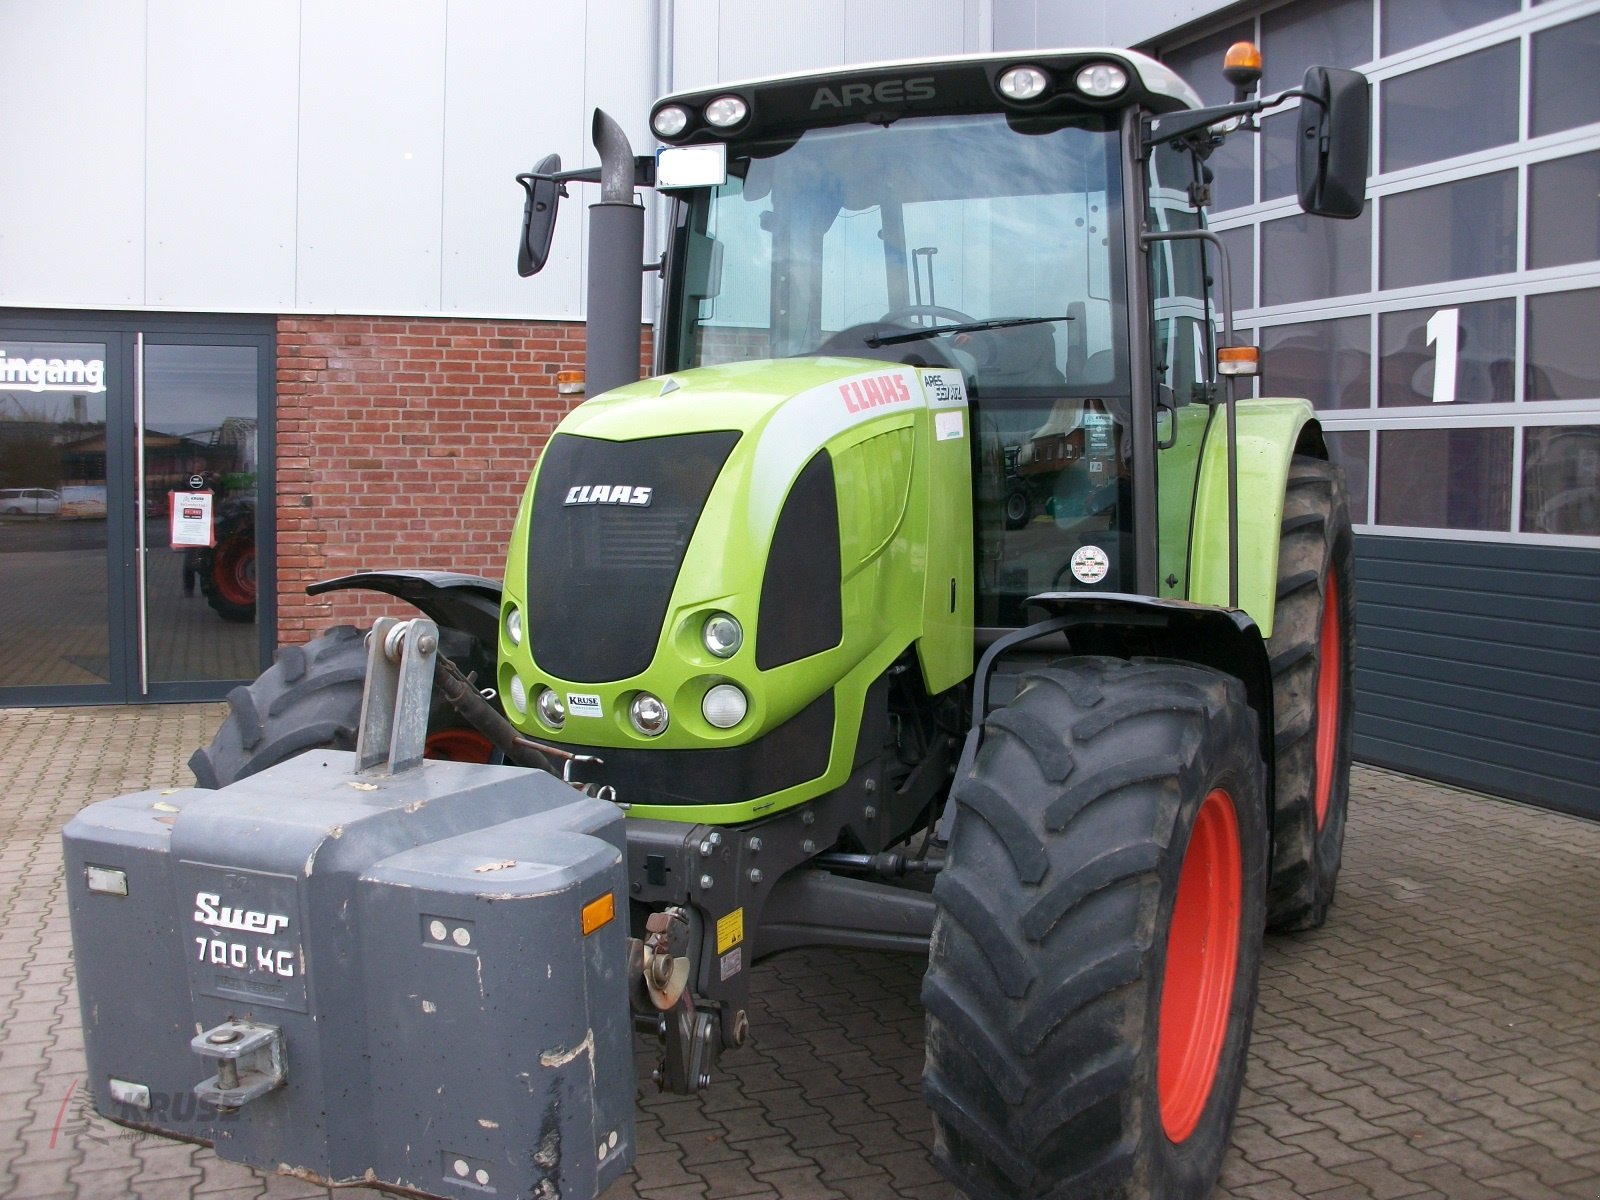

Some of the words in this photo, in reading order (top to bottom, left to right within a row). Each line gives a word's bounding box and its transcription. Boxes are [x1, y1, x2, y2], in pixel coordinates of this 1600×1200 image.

[809, 77, 937, 111] ARES
[1426, 308, 1459, 403] 1
[838, 374, 911, 414] CLAAS
[924, 375, 944, 388] ARES
[564, 484, 653, 507] CLAAS
[569, 696, 599, 706] KRUSE
[194, 892, 289, 935] Suer
[195, 937, 248, 968] 700
[257, 946, 294, 977] KG
